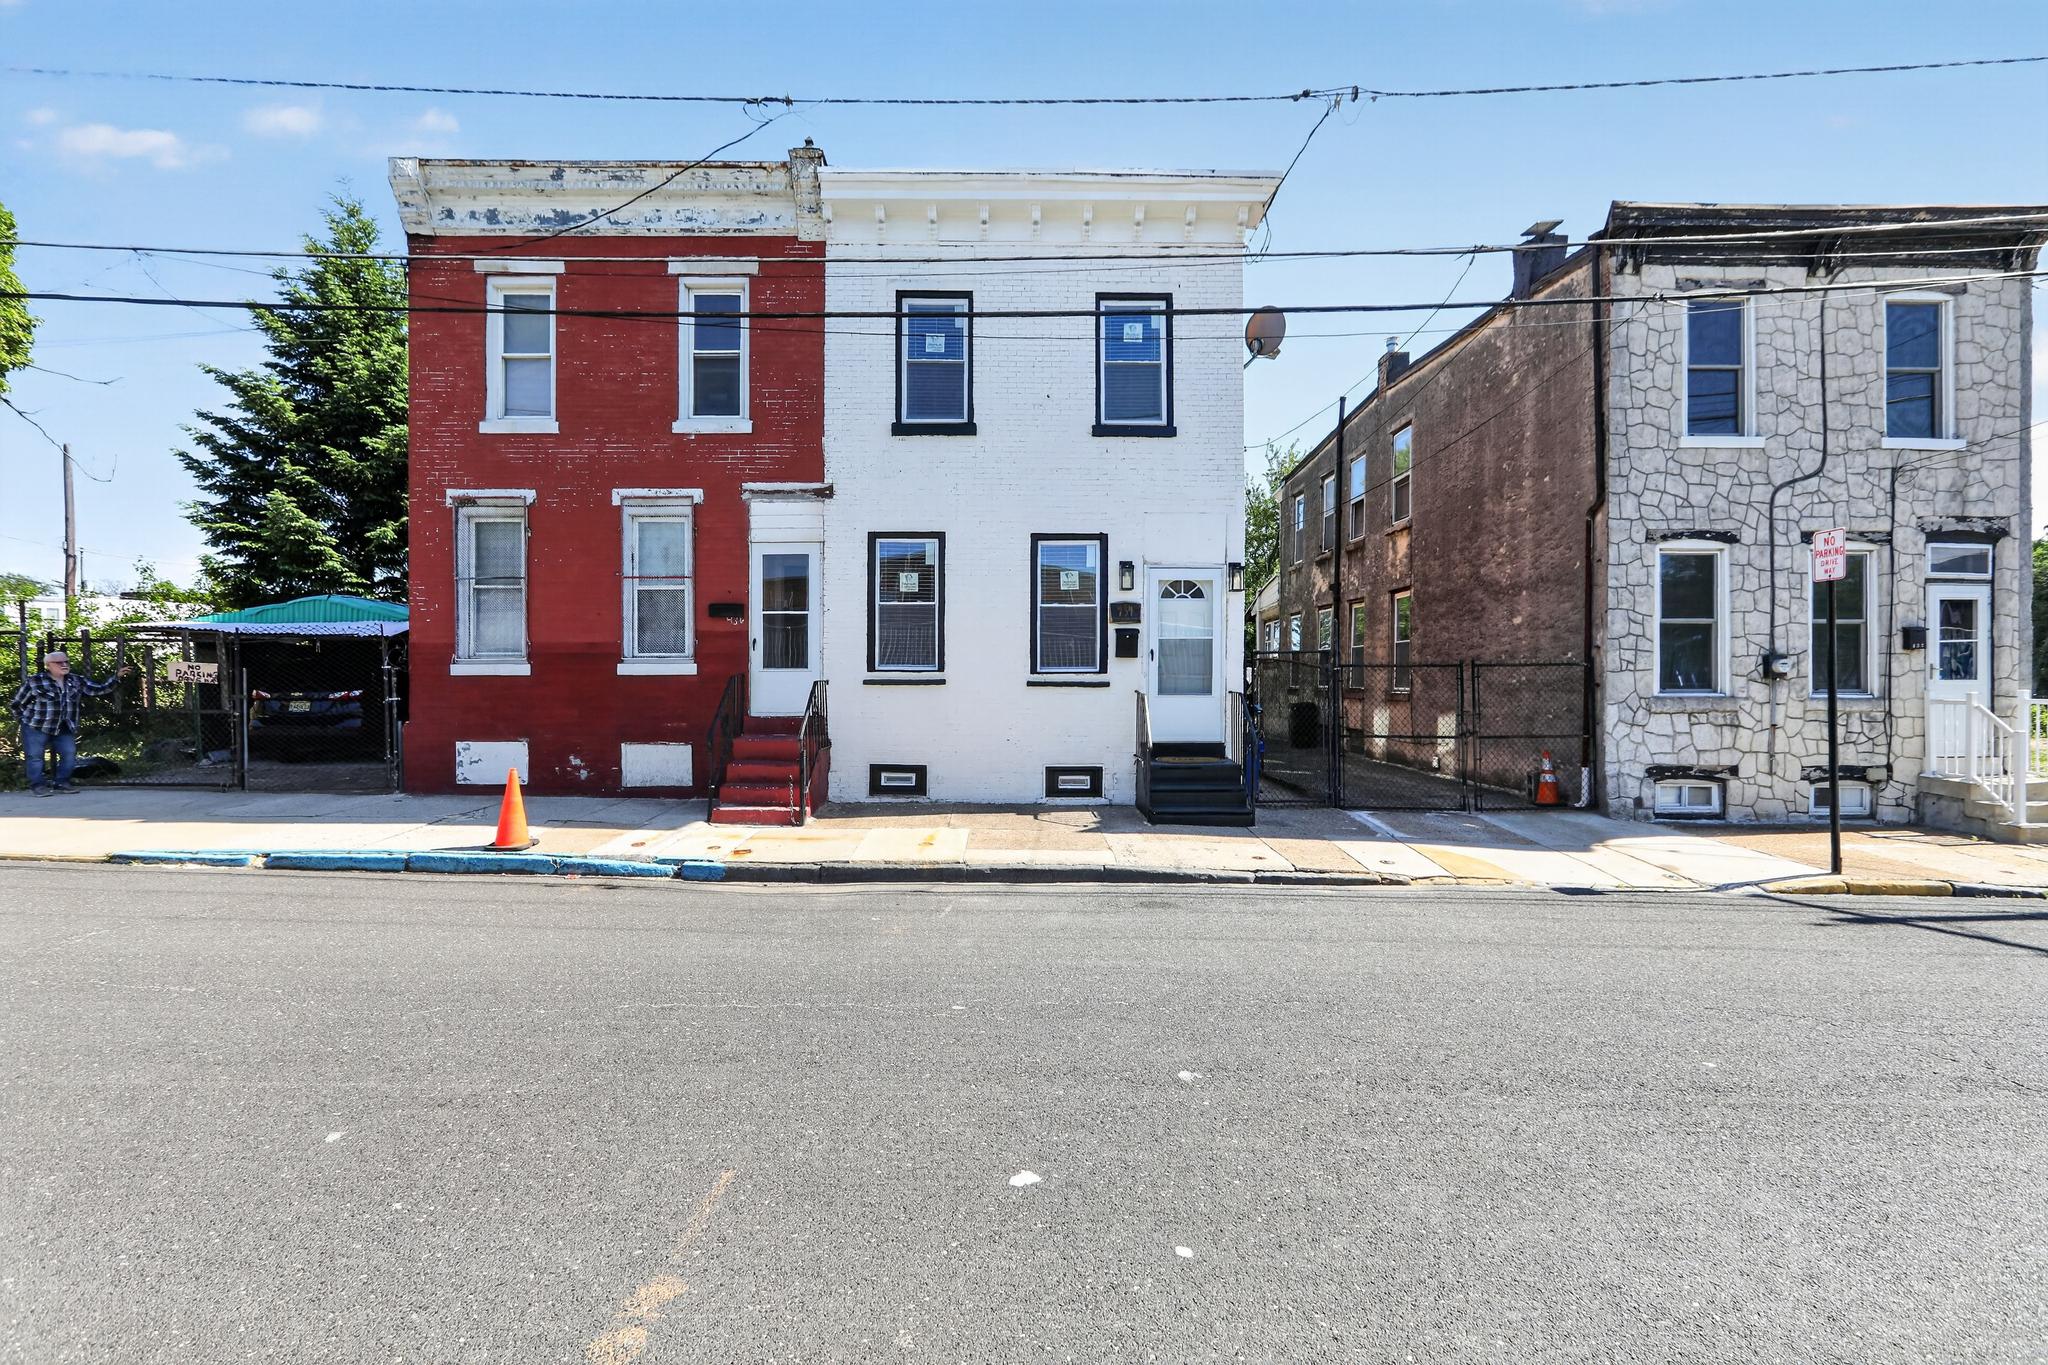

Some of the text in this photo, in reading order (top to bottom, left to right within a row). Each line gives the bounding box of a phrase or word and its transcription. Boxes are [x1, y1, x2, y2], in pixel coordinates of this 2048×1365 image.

[1824, 536, 1835, 547] NO
[1815, 545, 1844, 559] PARKING
[1820, 557, 1838, 567] DRIVE
[1823, 567, 1836, 575] WAY
